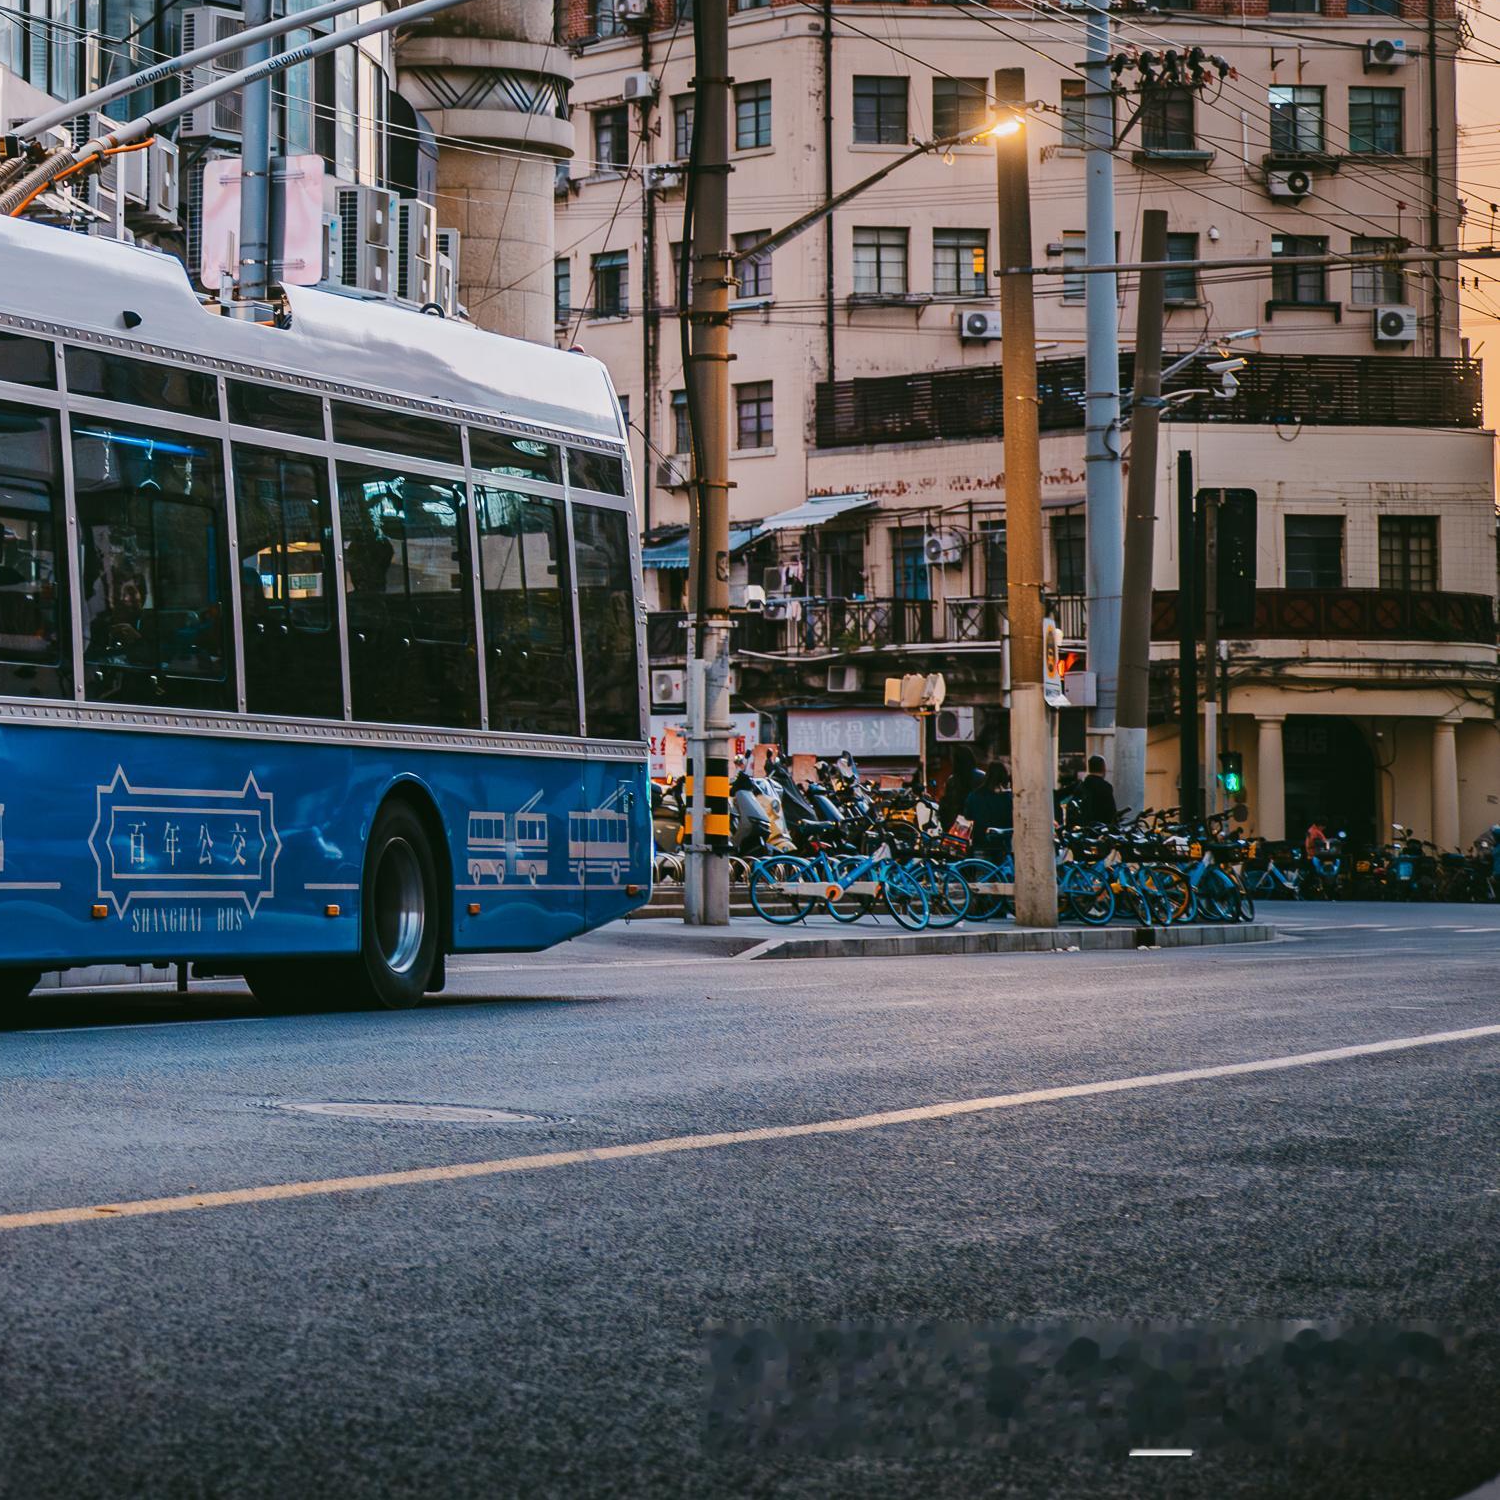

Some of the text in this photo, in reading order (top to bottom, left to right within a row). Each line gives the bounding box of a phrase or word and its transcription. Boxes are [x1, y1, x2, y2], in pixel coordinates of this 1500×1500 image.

[127, 820, 248, 868] 百年公交
[132, 907, 243, 933] SHANGHAI BUS
